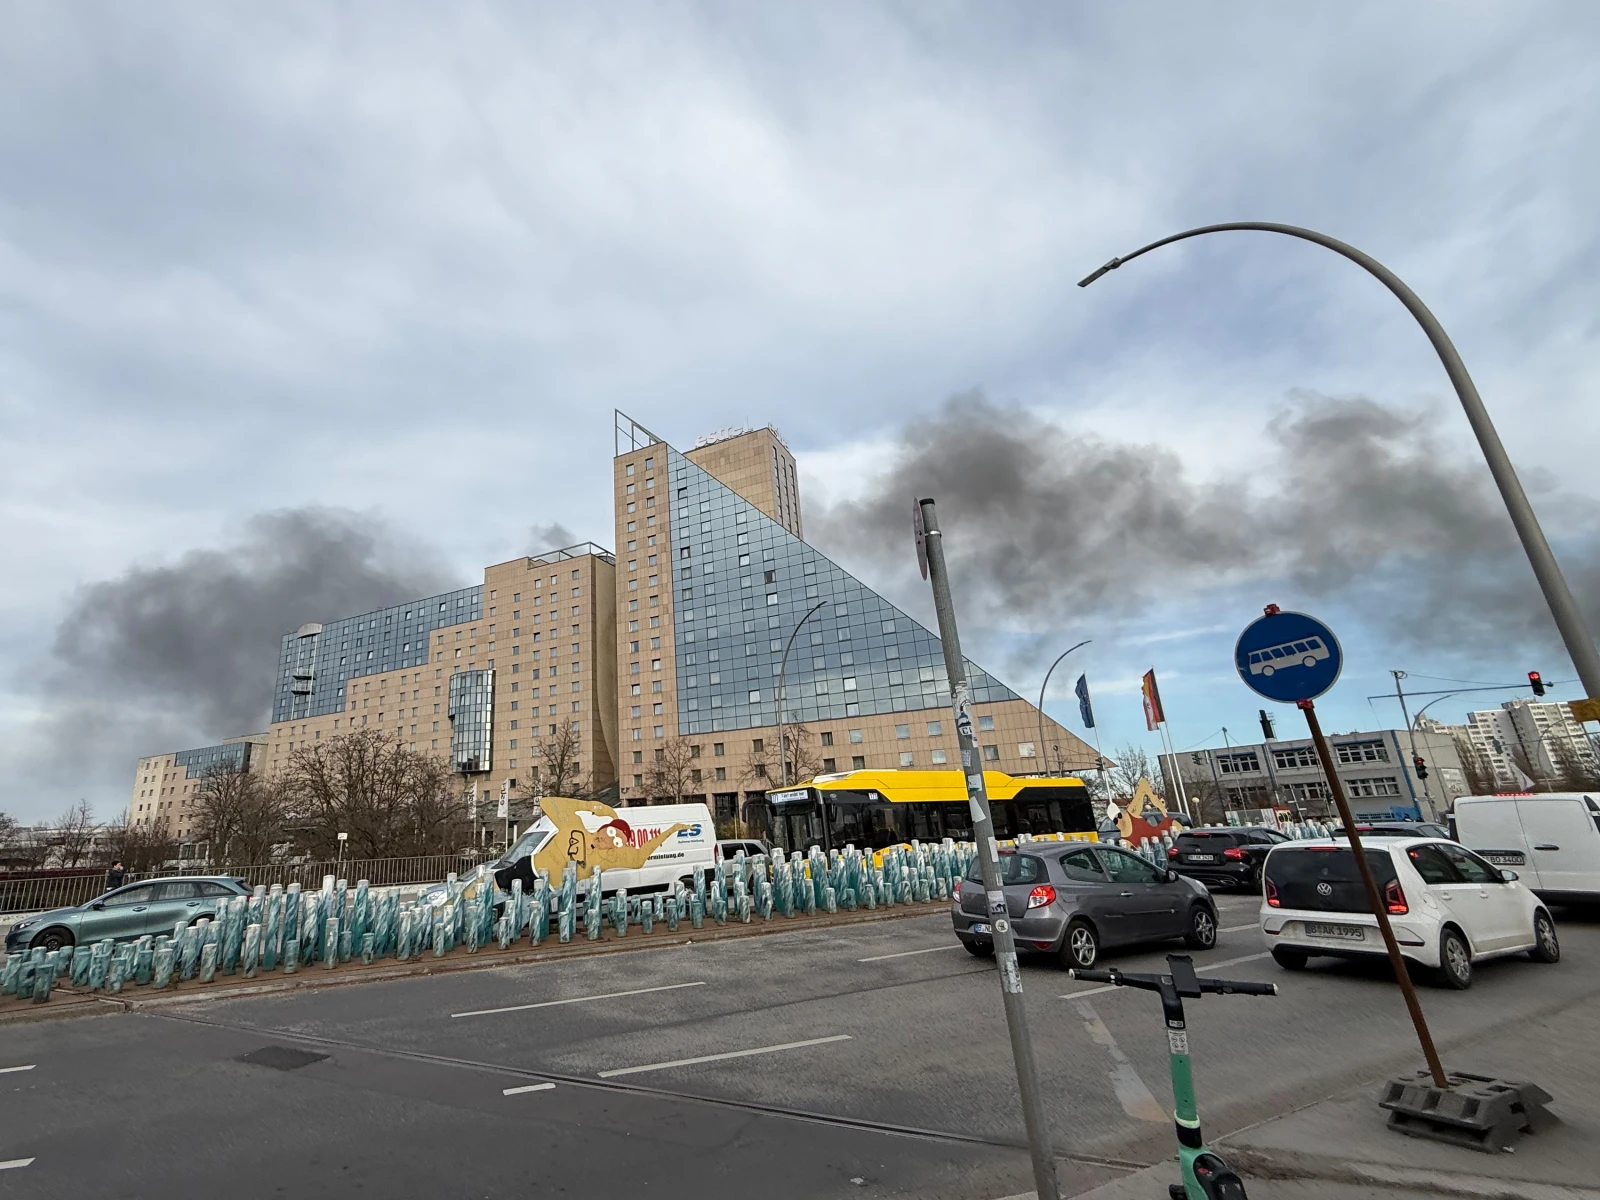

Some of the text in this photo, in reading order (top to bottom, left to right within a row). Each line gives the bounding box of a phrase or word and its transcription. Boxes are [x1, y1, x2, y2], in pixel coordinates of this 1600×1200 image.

[648, 852, 684, 860] ermietung.de
[1323, 926, 1335, 935] AK
[1337, 927, 1362, 937] 1995
